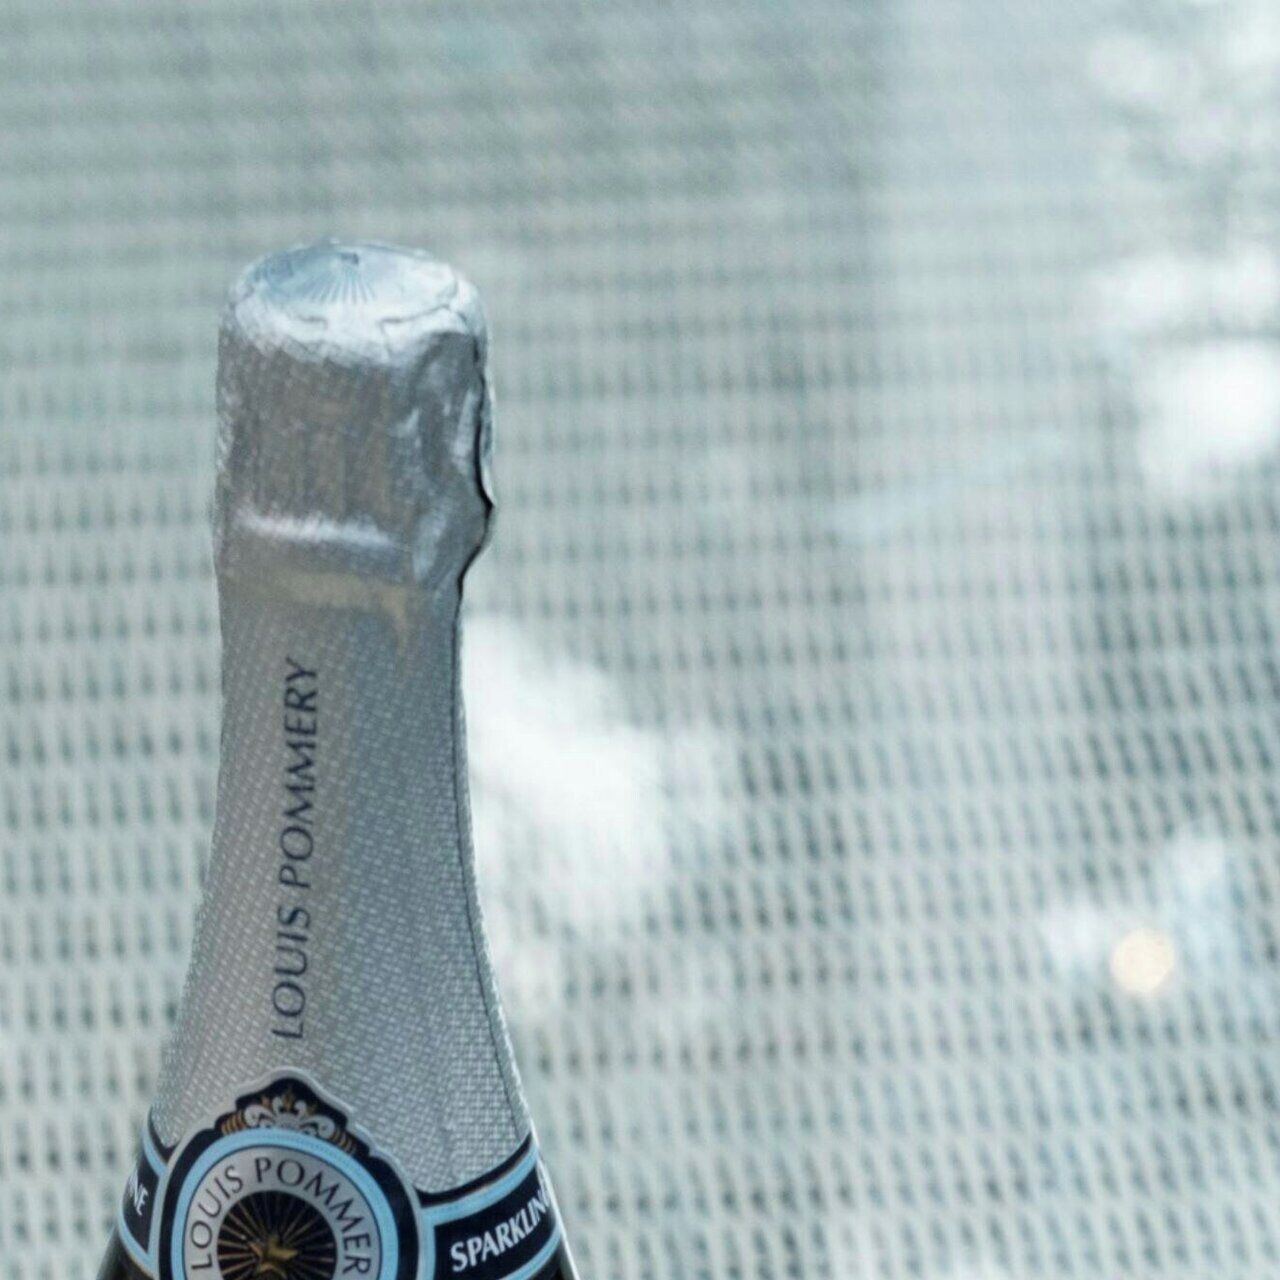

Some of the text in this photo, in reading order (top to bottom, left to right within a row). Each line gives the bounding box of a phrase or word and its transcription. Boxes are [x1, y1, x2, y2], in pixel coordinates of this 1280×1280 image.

[271, 656, 319, 1040] LOUIS POMMERY
[190, 1164, 245, 1271] LOUIS
[450, 1188, 551, 1272] SPARKLIN
